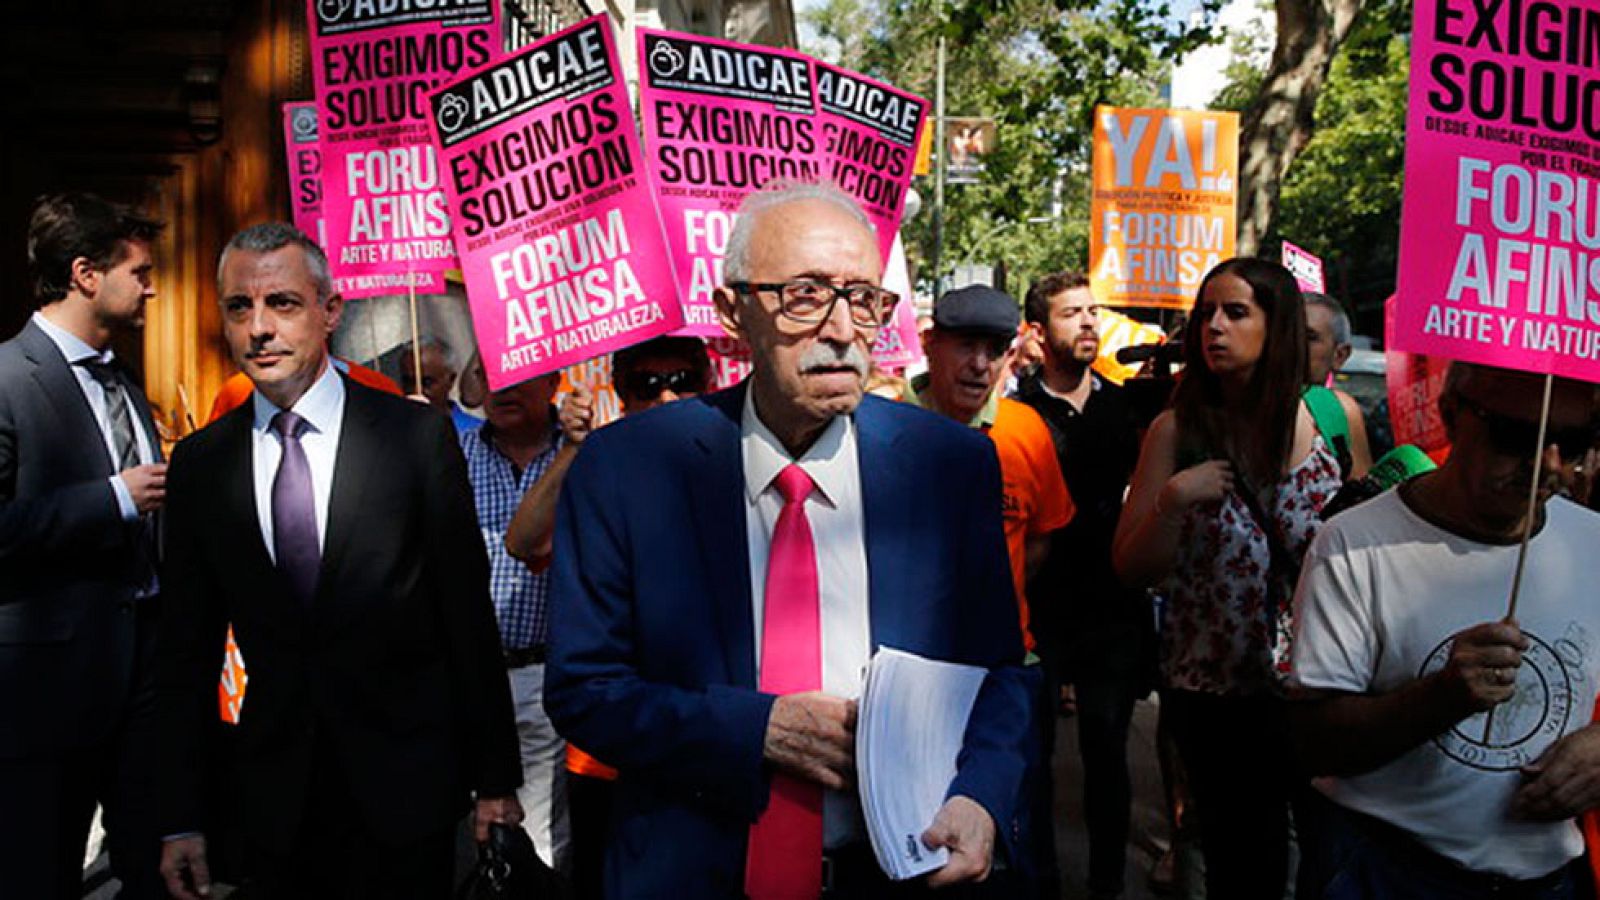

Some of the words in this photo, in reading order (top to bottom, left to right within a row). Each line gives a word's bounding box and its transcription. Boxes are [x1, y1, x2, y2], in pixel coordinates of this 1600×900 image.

[323, 29, 489, 86] EXIGIMOS
[1435, 0, 1600, 67] EXIGI
[472, 28, 606, 121] ADICAE
[688, 45, 811, 97] ADICAE
[1428, 53, 1600, 141] SOLUC
[326, 80, 430, 130] SOLUC
[655, 101, 816, 155] EXIGIMOS
[818, 71, 920, 133] ADICAE
[1425, 115, 1469, 137] DESDE
[1475, 125, 1525, 146] ADICAE
[346, 145, 438, 197] FORU
[451, 93, 618, 195] EXIGIMOS
[823, 122, 908, 177] GIMOS
[460, 135, 633, 236] SOLUCION
[1456, 156, 1600, 250] FORU
[350, 192, 451, 243] AFINS
[1103, 210, 1223, 250] FORUM
[340, 244, 378, 264] ARTE
[379, 243, 390, 261] Y
[393, 239, 455, 261] NATURA
[490, 208, 630, 300] FORUM
[1446, 232, 1600, 326] AFIN
[507, 258, 646, 347] AFINSA
[1424, 304, 1493, 344] ARTE
[1500, 315, 1516, 347] Y
[501, 343, 543, 373] ARTE
[542, 337, 553, 358] Y
[556, 301, 665, 353] NATURALEZA
